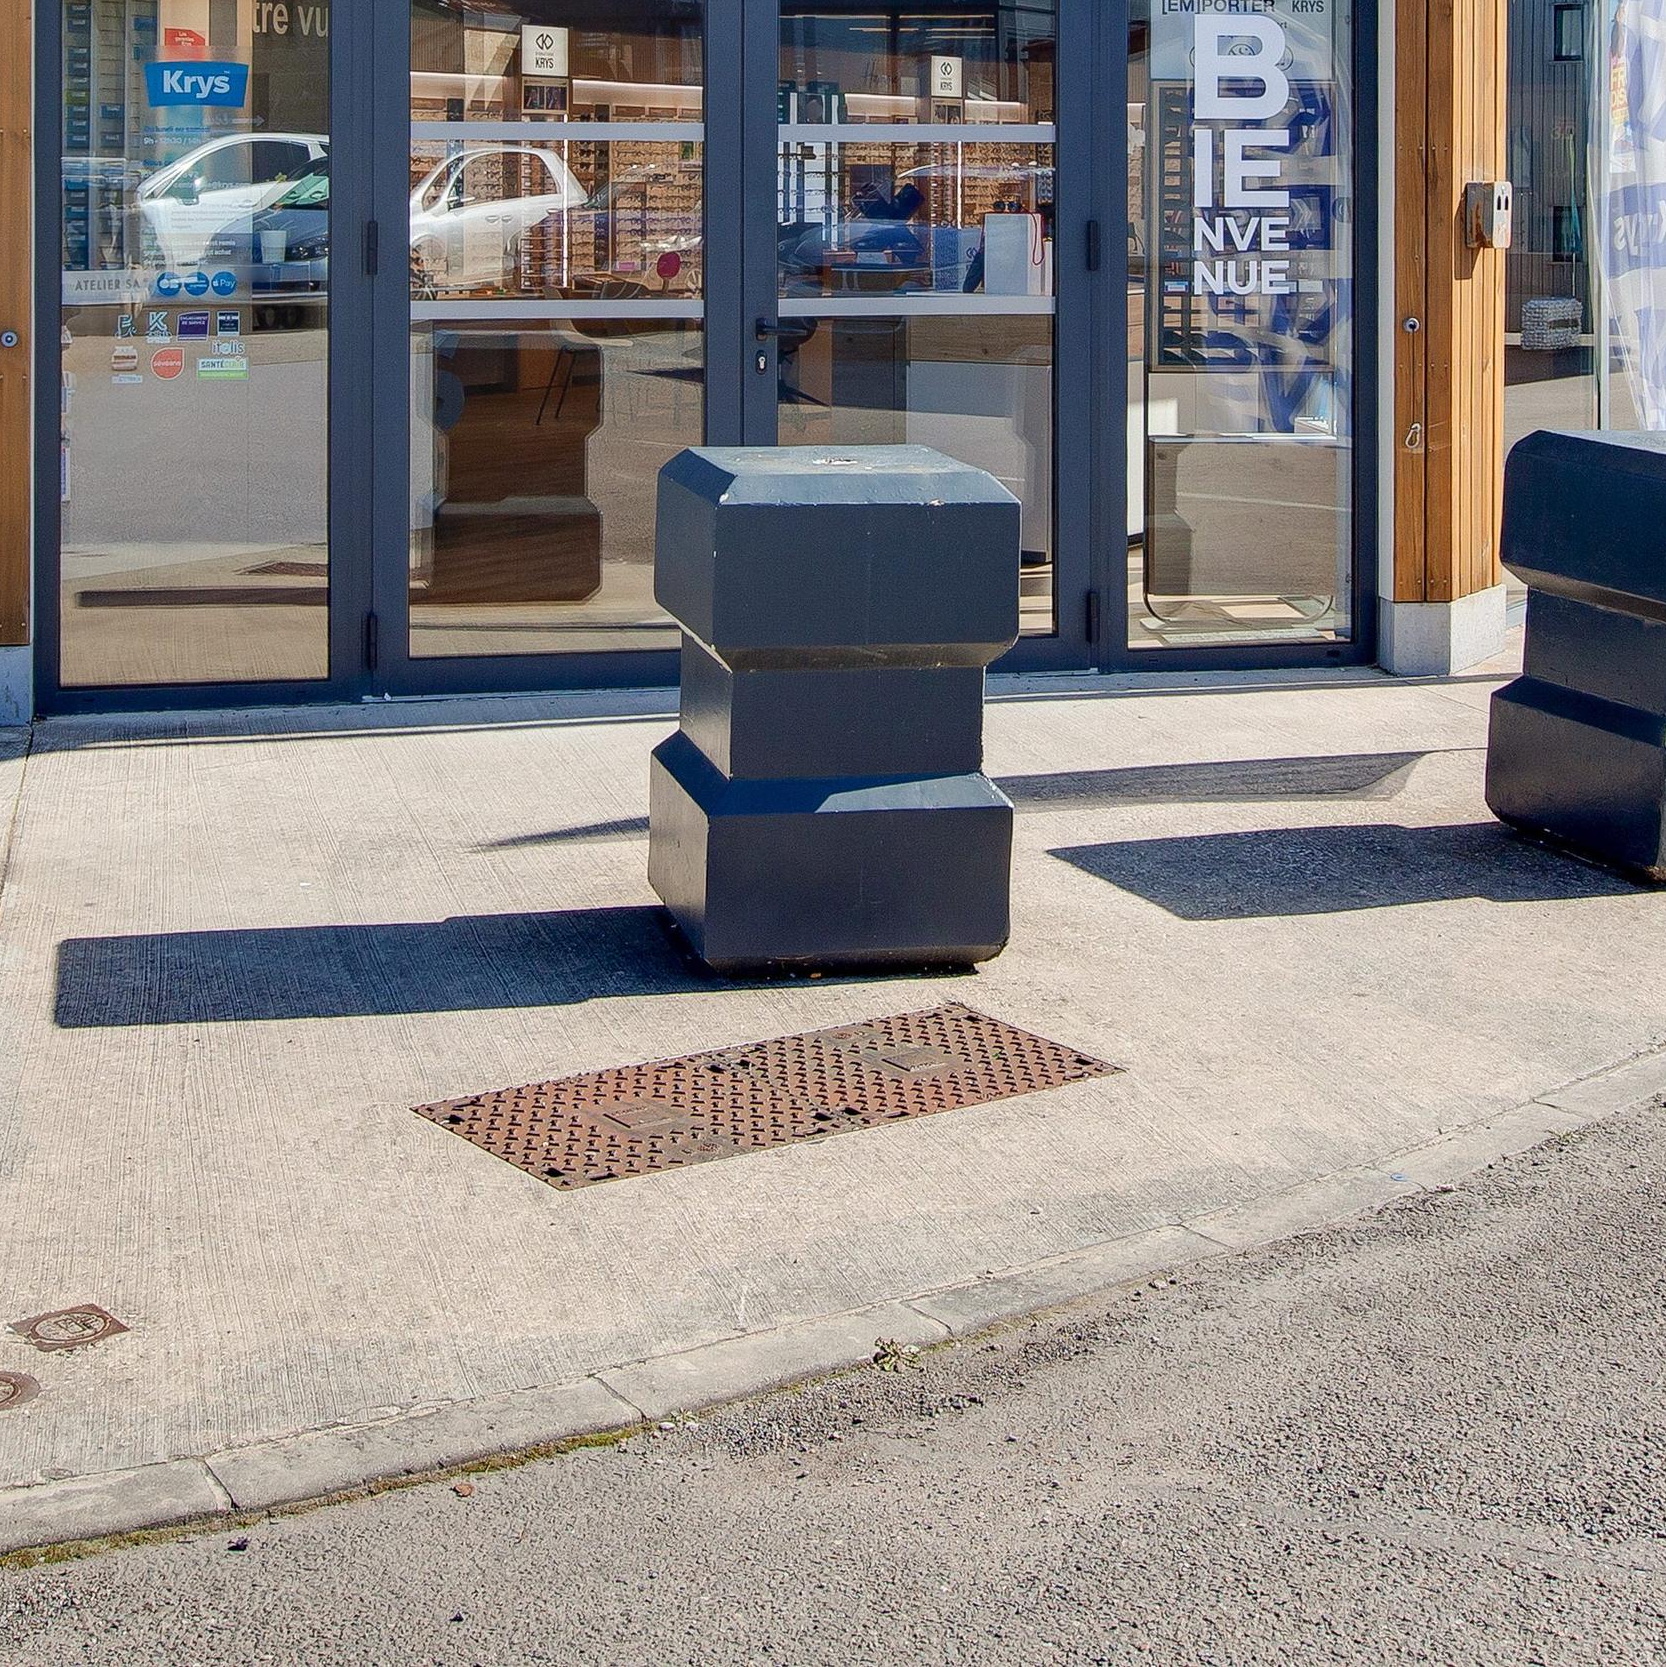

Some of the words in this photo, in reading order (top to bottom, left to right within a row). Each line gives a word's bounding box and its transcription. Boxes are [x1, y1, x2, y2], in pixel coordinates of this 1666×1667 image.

[1292, 0, 1325, 13] KRYS
[163, 70, 230, 98] Krys
[75, 279, 121, 291] ATELIER
